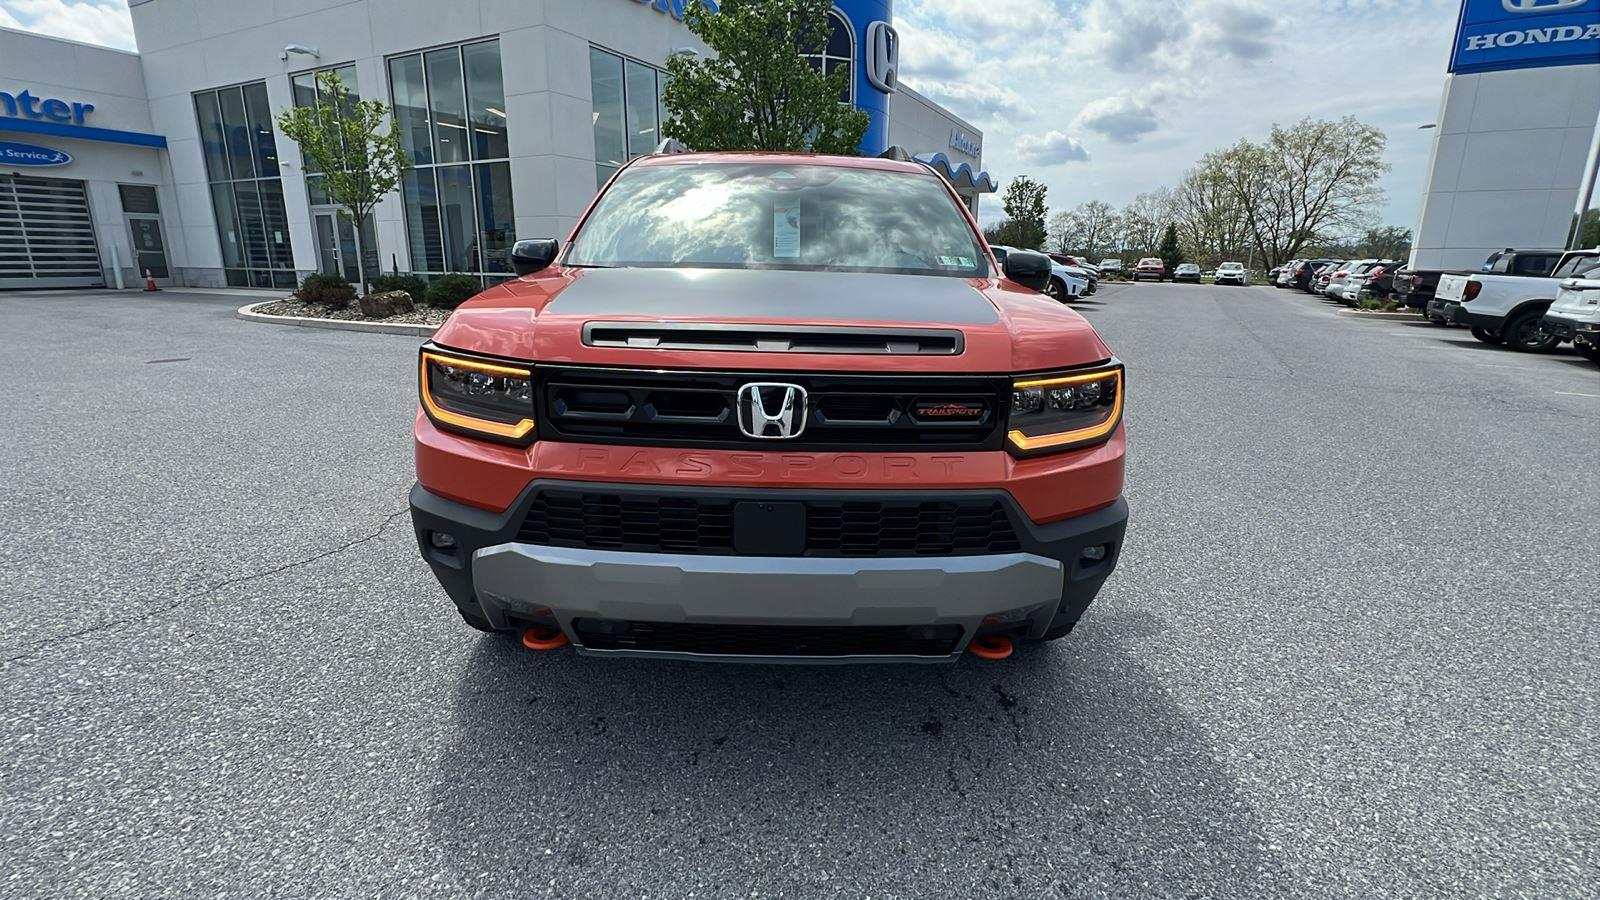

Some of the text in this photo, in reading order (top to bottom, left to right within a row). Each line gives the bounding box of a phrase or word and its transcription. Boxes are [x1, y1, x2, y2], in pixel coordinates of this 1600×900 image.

[1465, 24, 1600, 51] HONDA
[6, 149, 48, 160] Service
[918, 408, 982, 416] TRAILSPORT
[576, 446, 965, 482] PASSPORT
